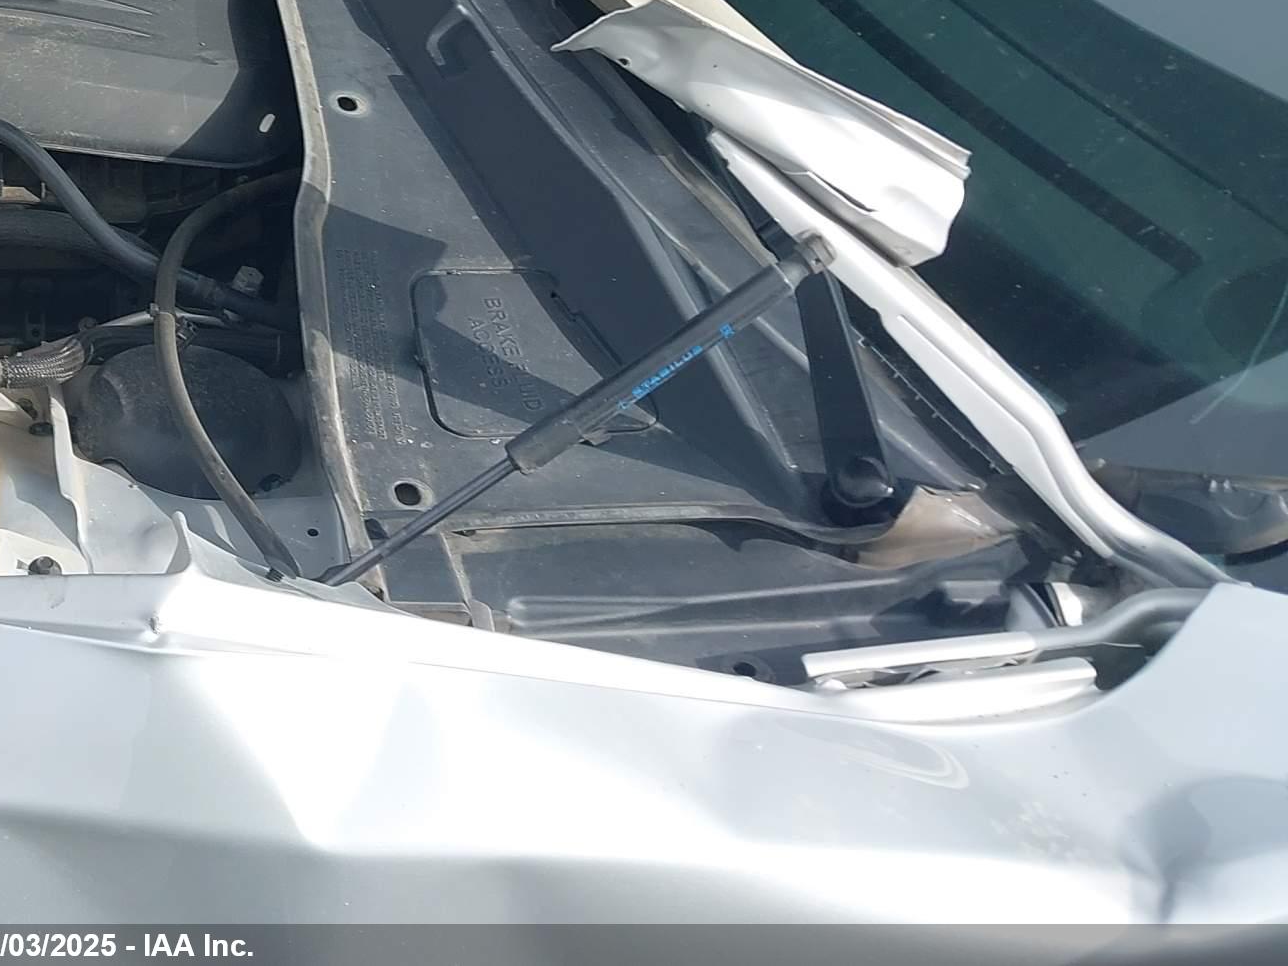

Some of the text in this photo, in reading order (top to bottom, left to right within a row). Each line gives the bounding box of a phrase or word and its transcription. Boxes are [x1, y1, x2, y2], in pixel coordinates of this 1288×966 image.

[467, 316, 510, 388] ACCESS
[483, 296, 545, 413] BRAKE FLUID
